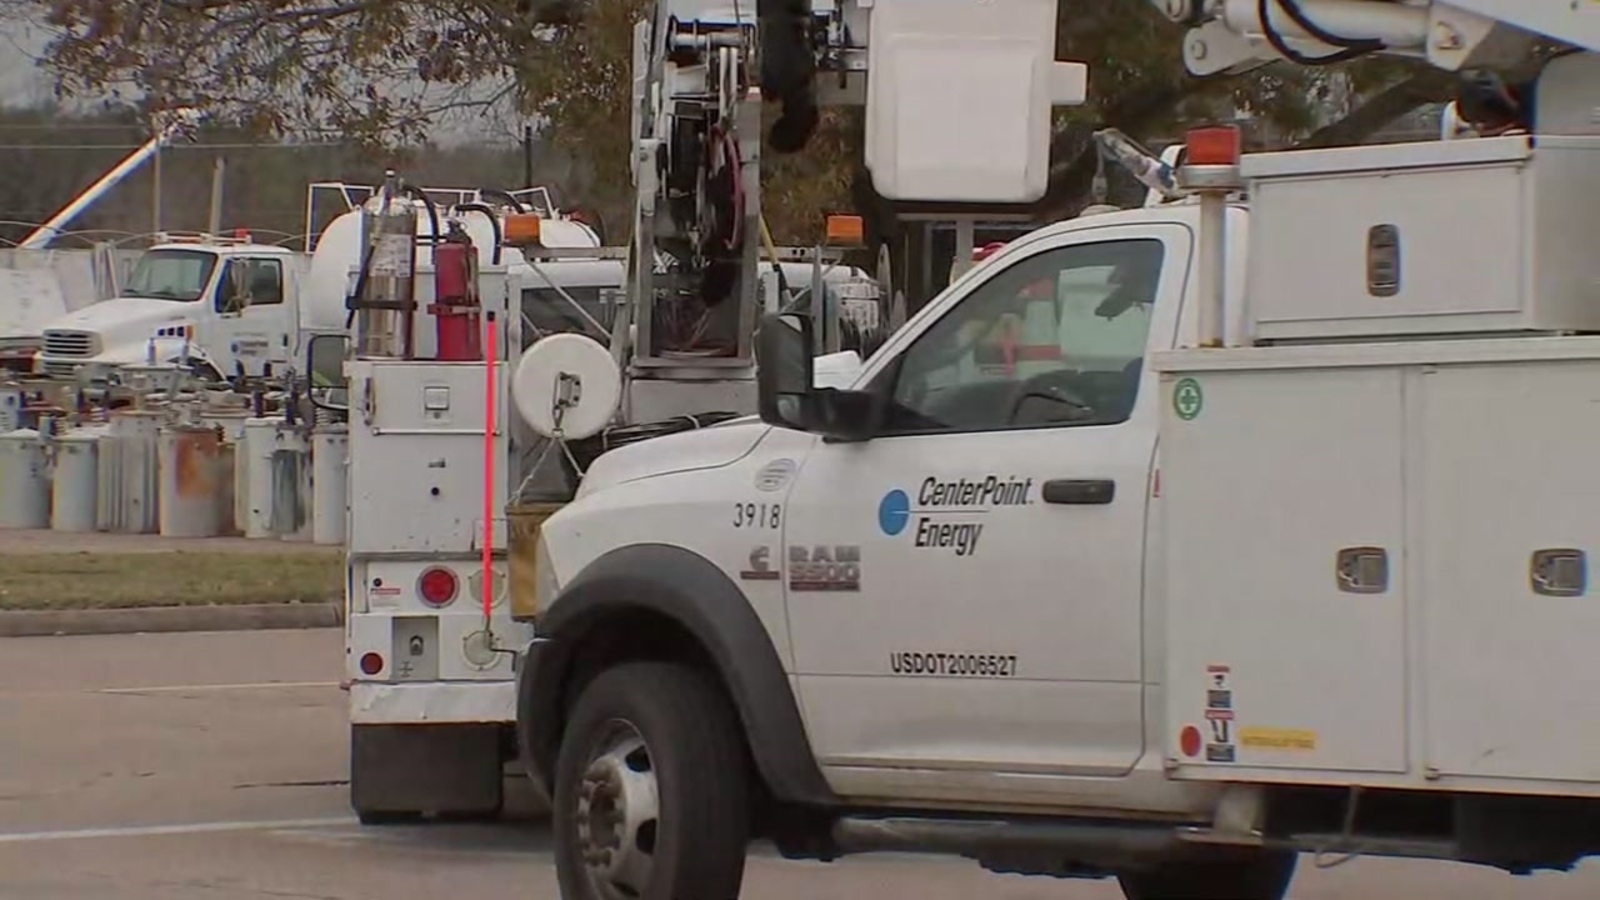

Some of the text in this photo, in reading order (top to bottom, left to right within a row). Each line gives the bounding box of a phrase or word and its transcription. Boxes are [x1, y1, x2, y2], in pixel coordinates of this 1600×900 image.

[917, 476, 1033, 507] CenterPoint
[733, 503, 781, 529] 3918
[915, 517, 984, 556] Energy
[891, 652, 1018, 677] USDOT2006527
